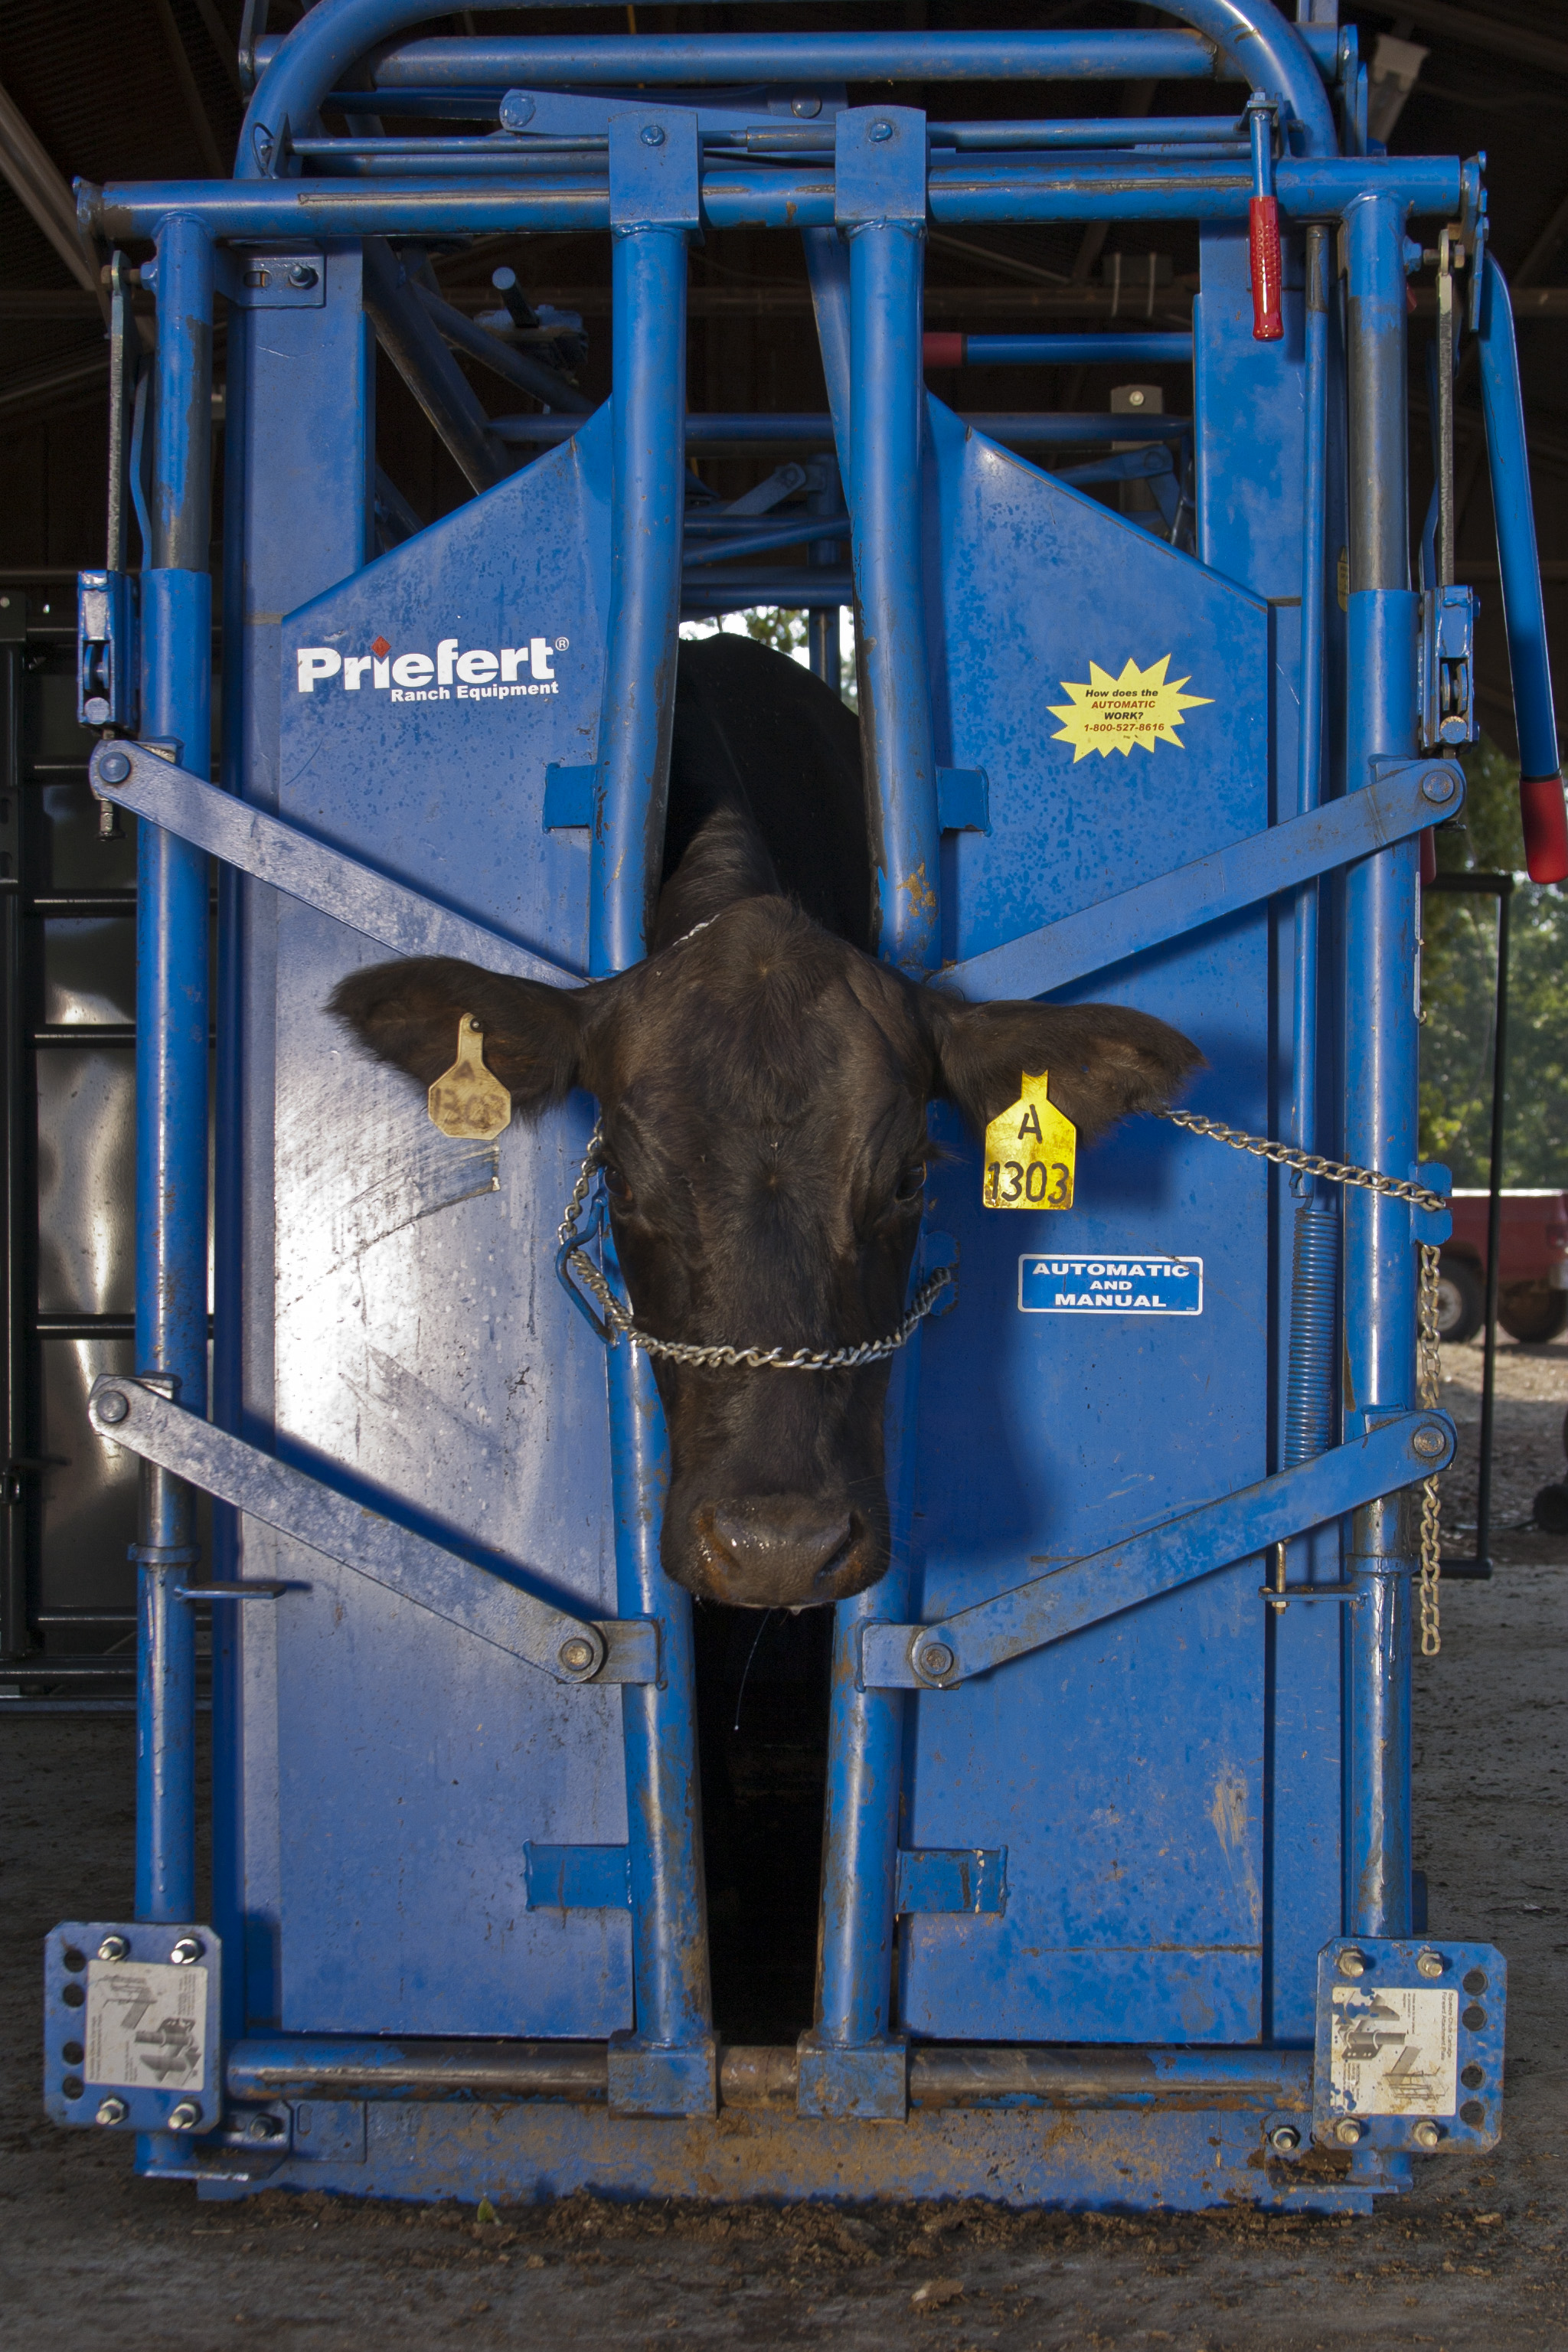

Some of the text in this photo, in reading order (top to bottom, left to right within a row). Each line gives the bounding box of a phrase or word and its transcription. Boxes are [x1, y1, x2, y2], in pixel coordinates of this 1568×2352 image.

[391, 681, 559, 702] Ranch Equipment
[1091, 701, 1156, 709] AUTOMATIC
[1084, 724, 1165, 732] 1-800-527-8616
[1018, 1103, 1043, 1144] A
[988, 1161, 1070, 1204] 1303
[1032, 1263, 1190, 1277] AUTOMATIC
[1089, 1280, 1132, 1290] AND
[1054, 1294, 1167, 1308] MANUAL
